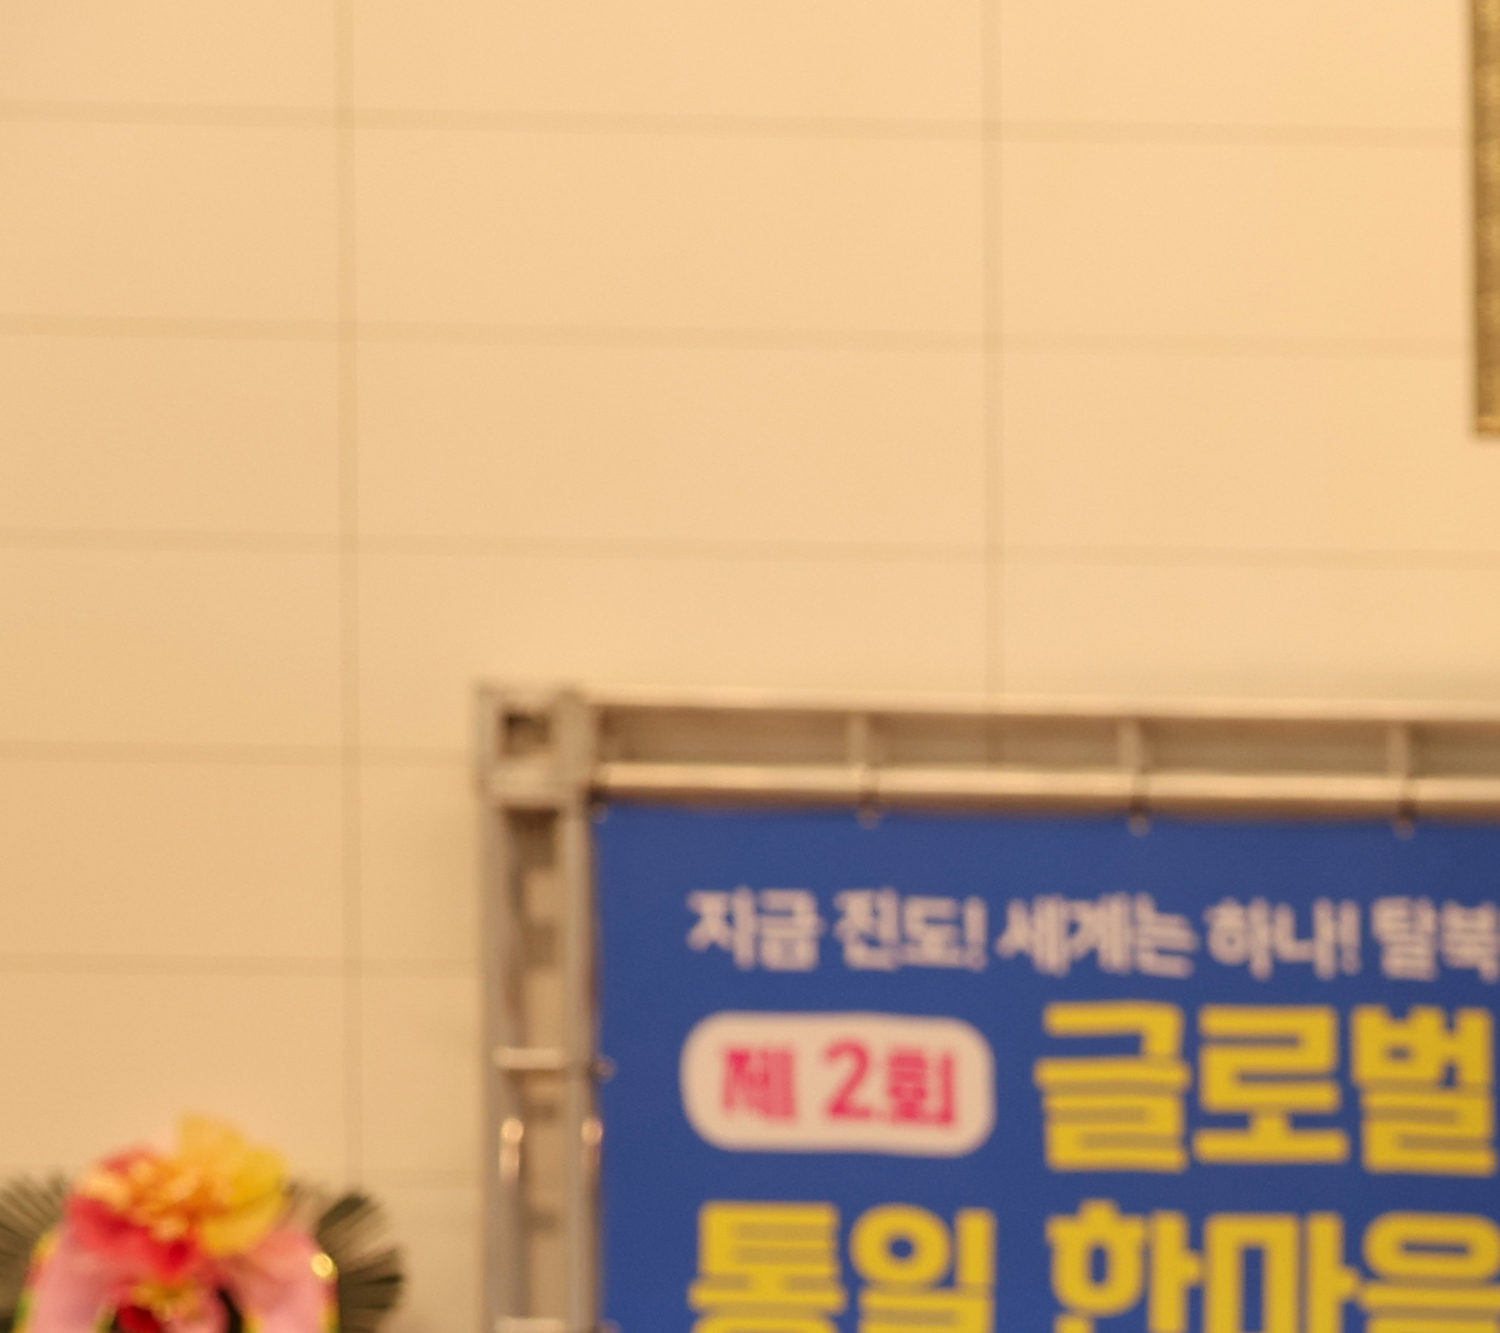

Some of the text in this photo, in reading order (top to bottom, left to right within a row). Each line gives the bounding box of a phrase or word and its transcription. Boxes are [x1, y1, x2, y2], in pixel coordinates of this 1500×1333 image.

[688, 887, 823, 971] 지금
[833, 887, 988, 972] 진도!
[996, 892, 1197, 979] 세계는
[1206, 897, 1361, 980] 하나!
[1034, 1001, 1498, 1175] 글로벌
